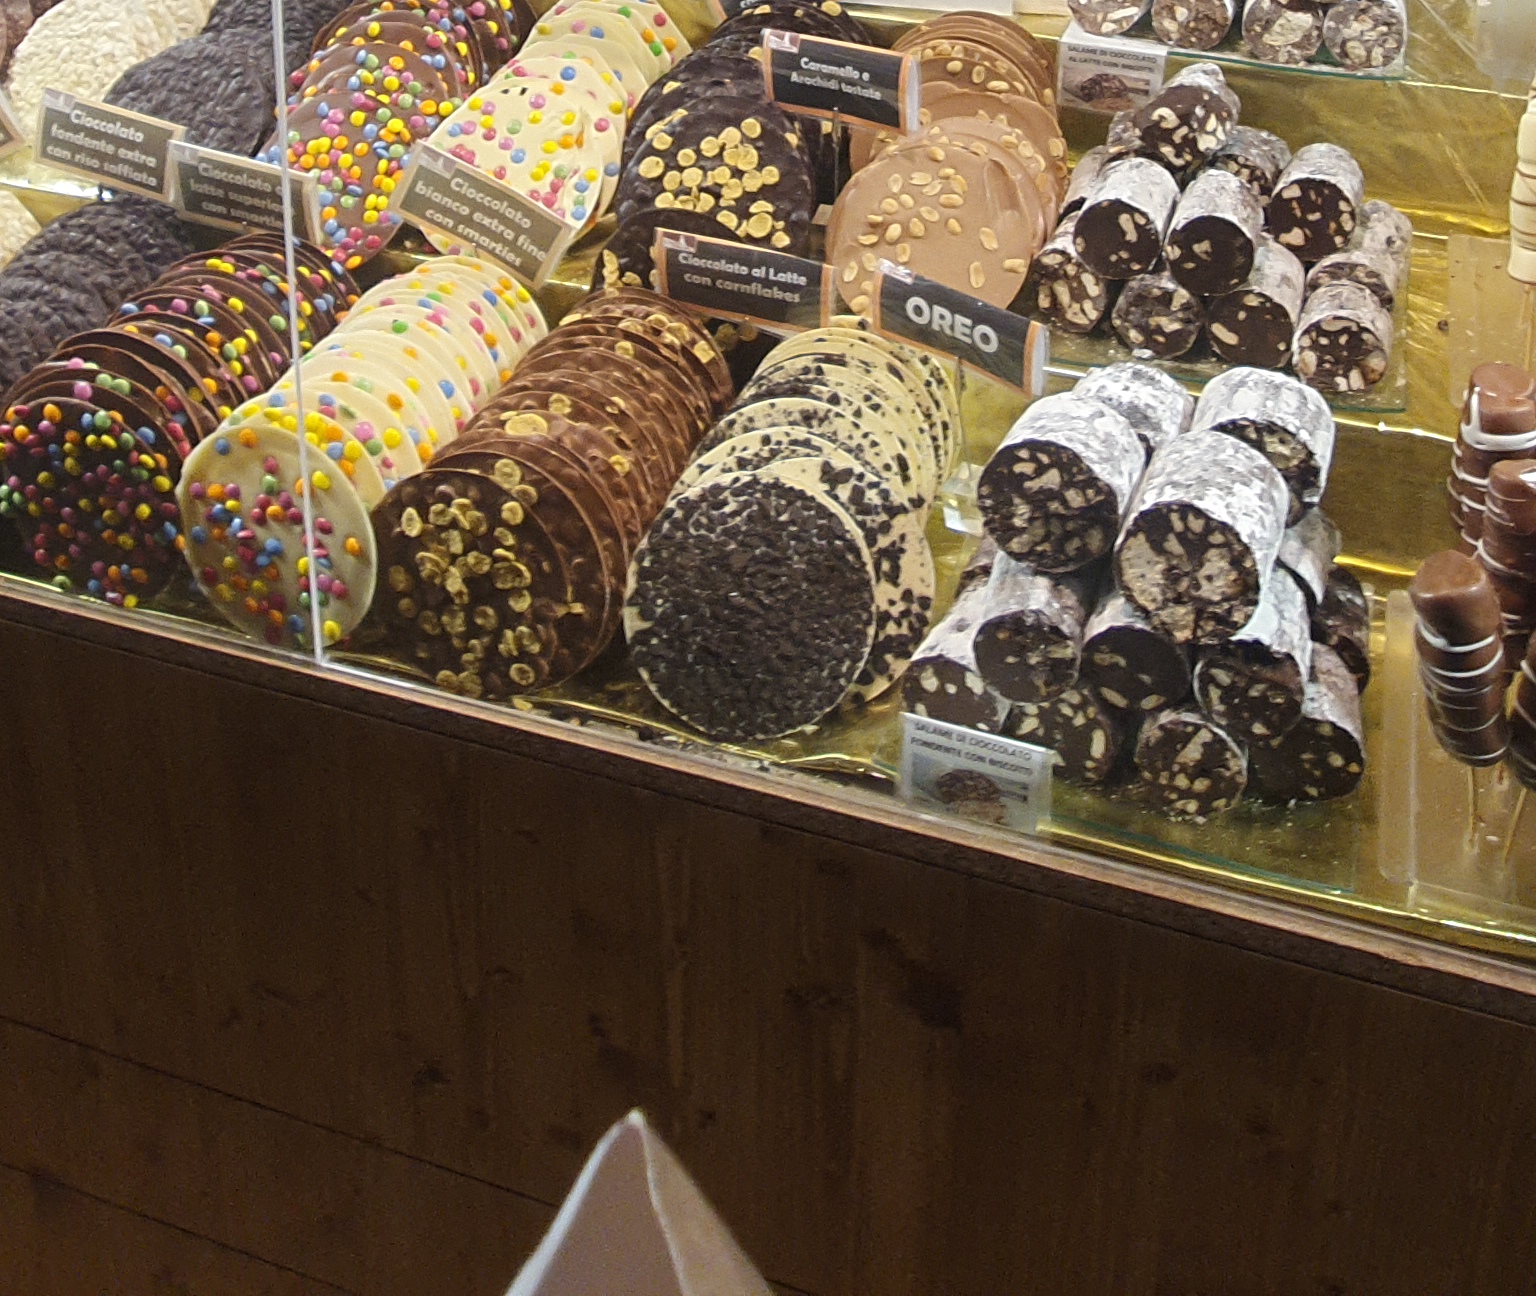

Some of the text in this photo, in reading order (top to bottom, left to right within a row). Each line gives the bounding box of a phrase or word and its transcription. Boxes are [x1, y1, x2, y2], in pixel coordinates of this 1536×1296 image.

[790, 71, 840, 91] Arachidi
[800, 56, 871, 81] Caramello e
[69, 108, 145, 143] Cioccolato
[46, 144, 73, 160] con
[116, 146, 158, 168] extra
[198, 162, 272, 193] Cioccolato
[414, 180, 470, 217] bianco
[472, 211, 516, 241] extra
[450, 176, 533, 230] Cioccolato
[425, 208, 523, 268] con smarties
[678, 251, 808, 287] Cioccolato al Latte
[683, 271, 801, 304] con cornflakes
[904, 296, 999, 354] OREO
